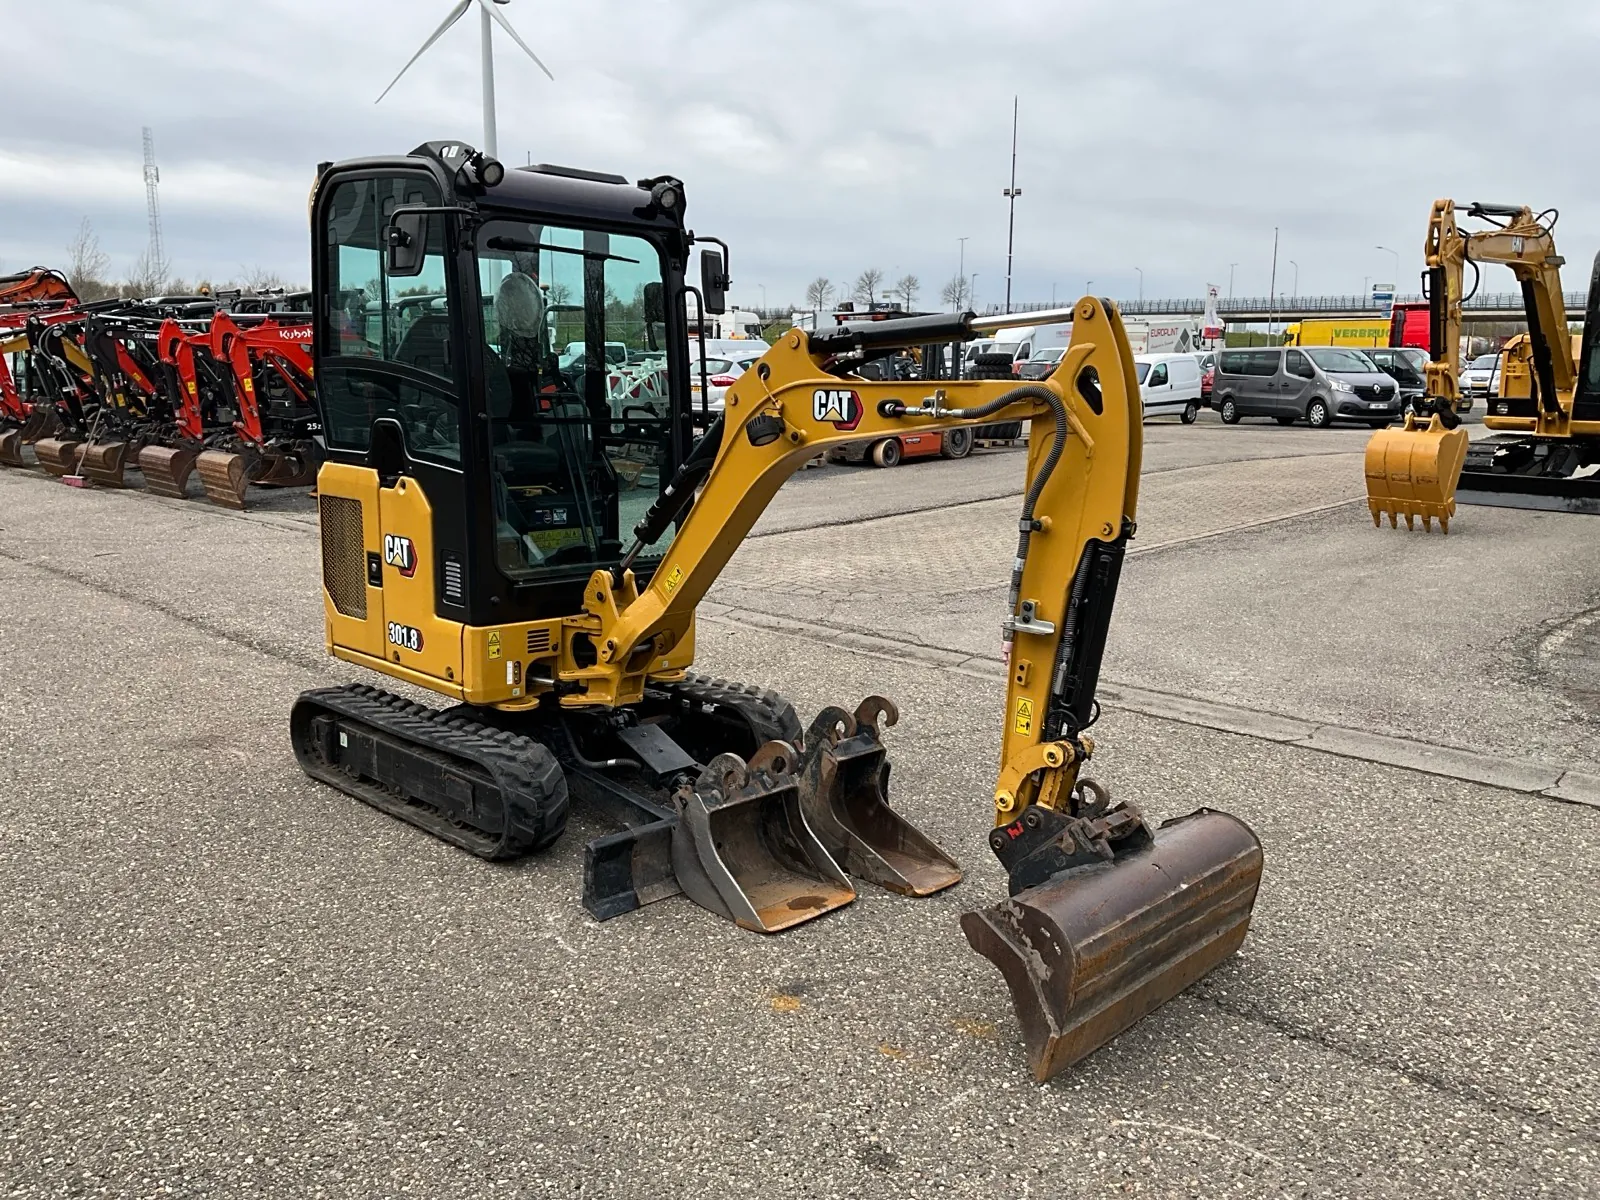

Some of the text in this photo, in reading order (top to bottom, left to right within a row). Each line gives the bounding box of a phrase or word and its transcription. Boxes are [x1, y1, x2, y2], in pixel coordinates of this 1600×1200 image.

[279, 329, 313, 340] Kubot
[813, 390, 852, 421] CAT
[385, 535, 410, 568] CAT
[388, 622, 418, 650] 301.8
